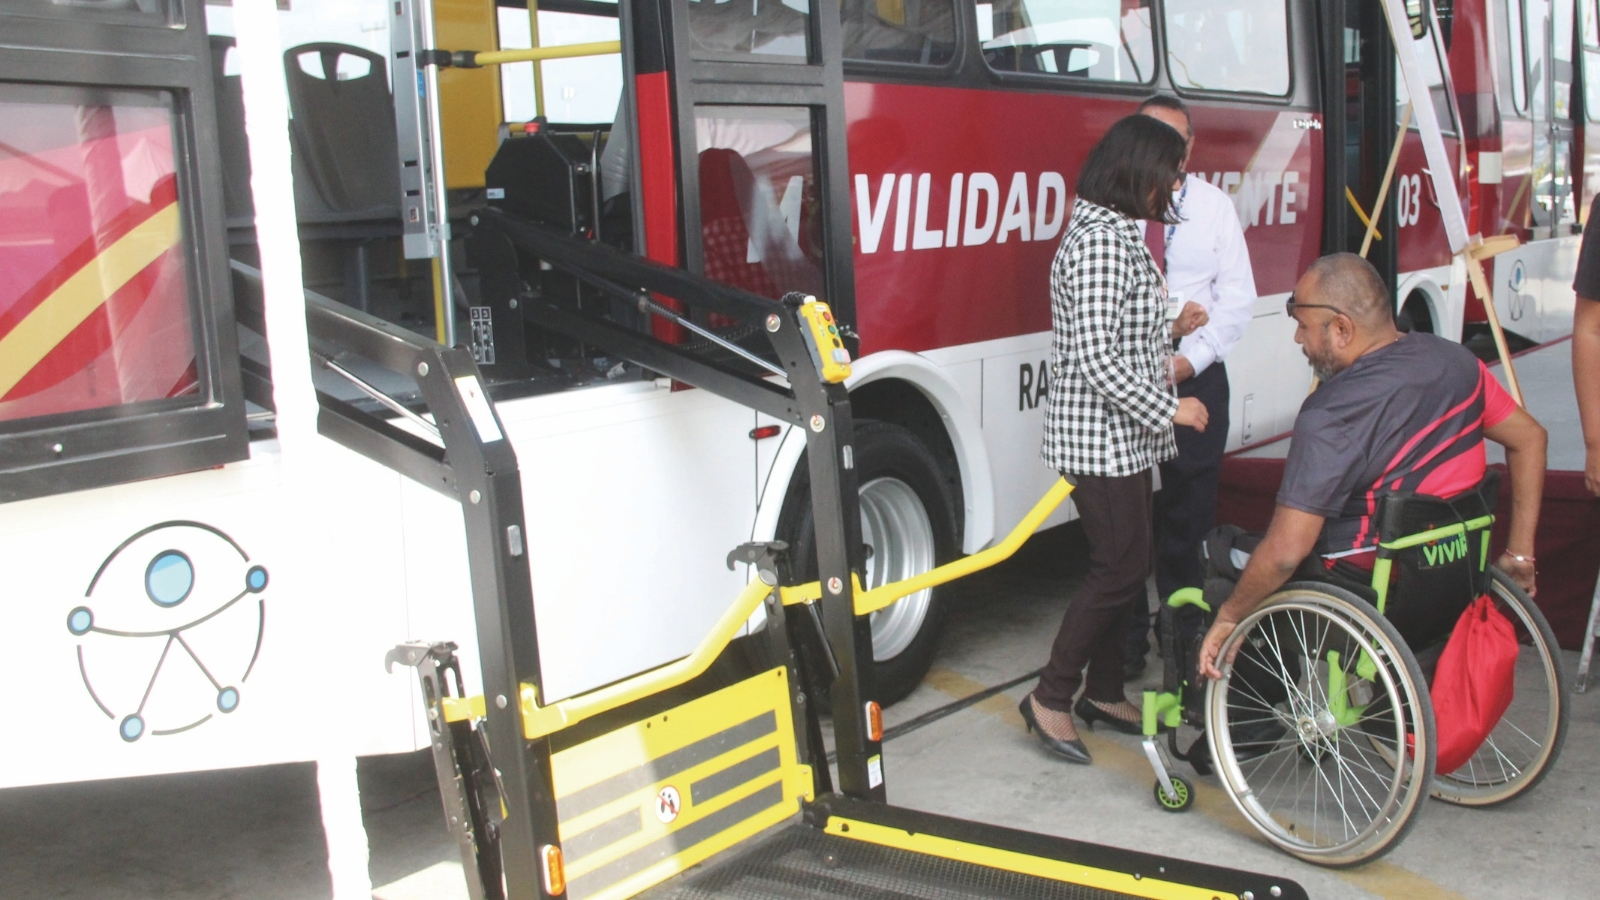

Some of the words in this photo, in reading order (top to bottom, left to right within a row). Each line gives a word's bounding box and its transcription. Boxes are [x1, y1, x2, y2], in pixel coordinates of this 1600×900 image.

[747, 172, 1066, 263] MVILIDAD
[1397, 173, 1421, 228] 03
[1019, 360, 1050, 412] RA
